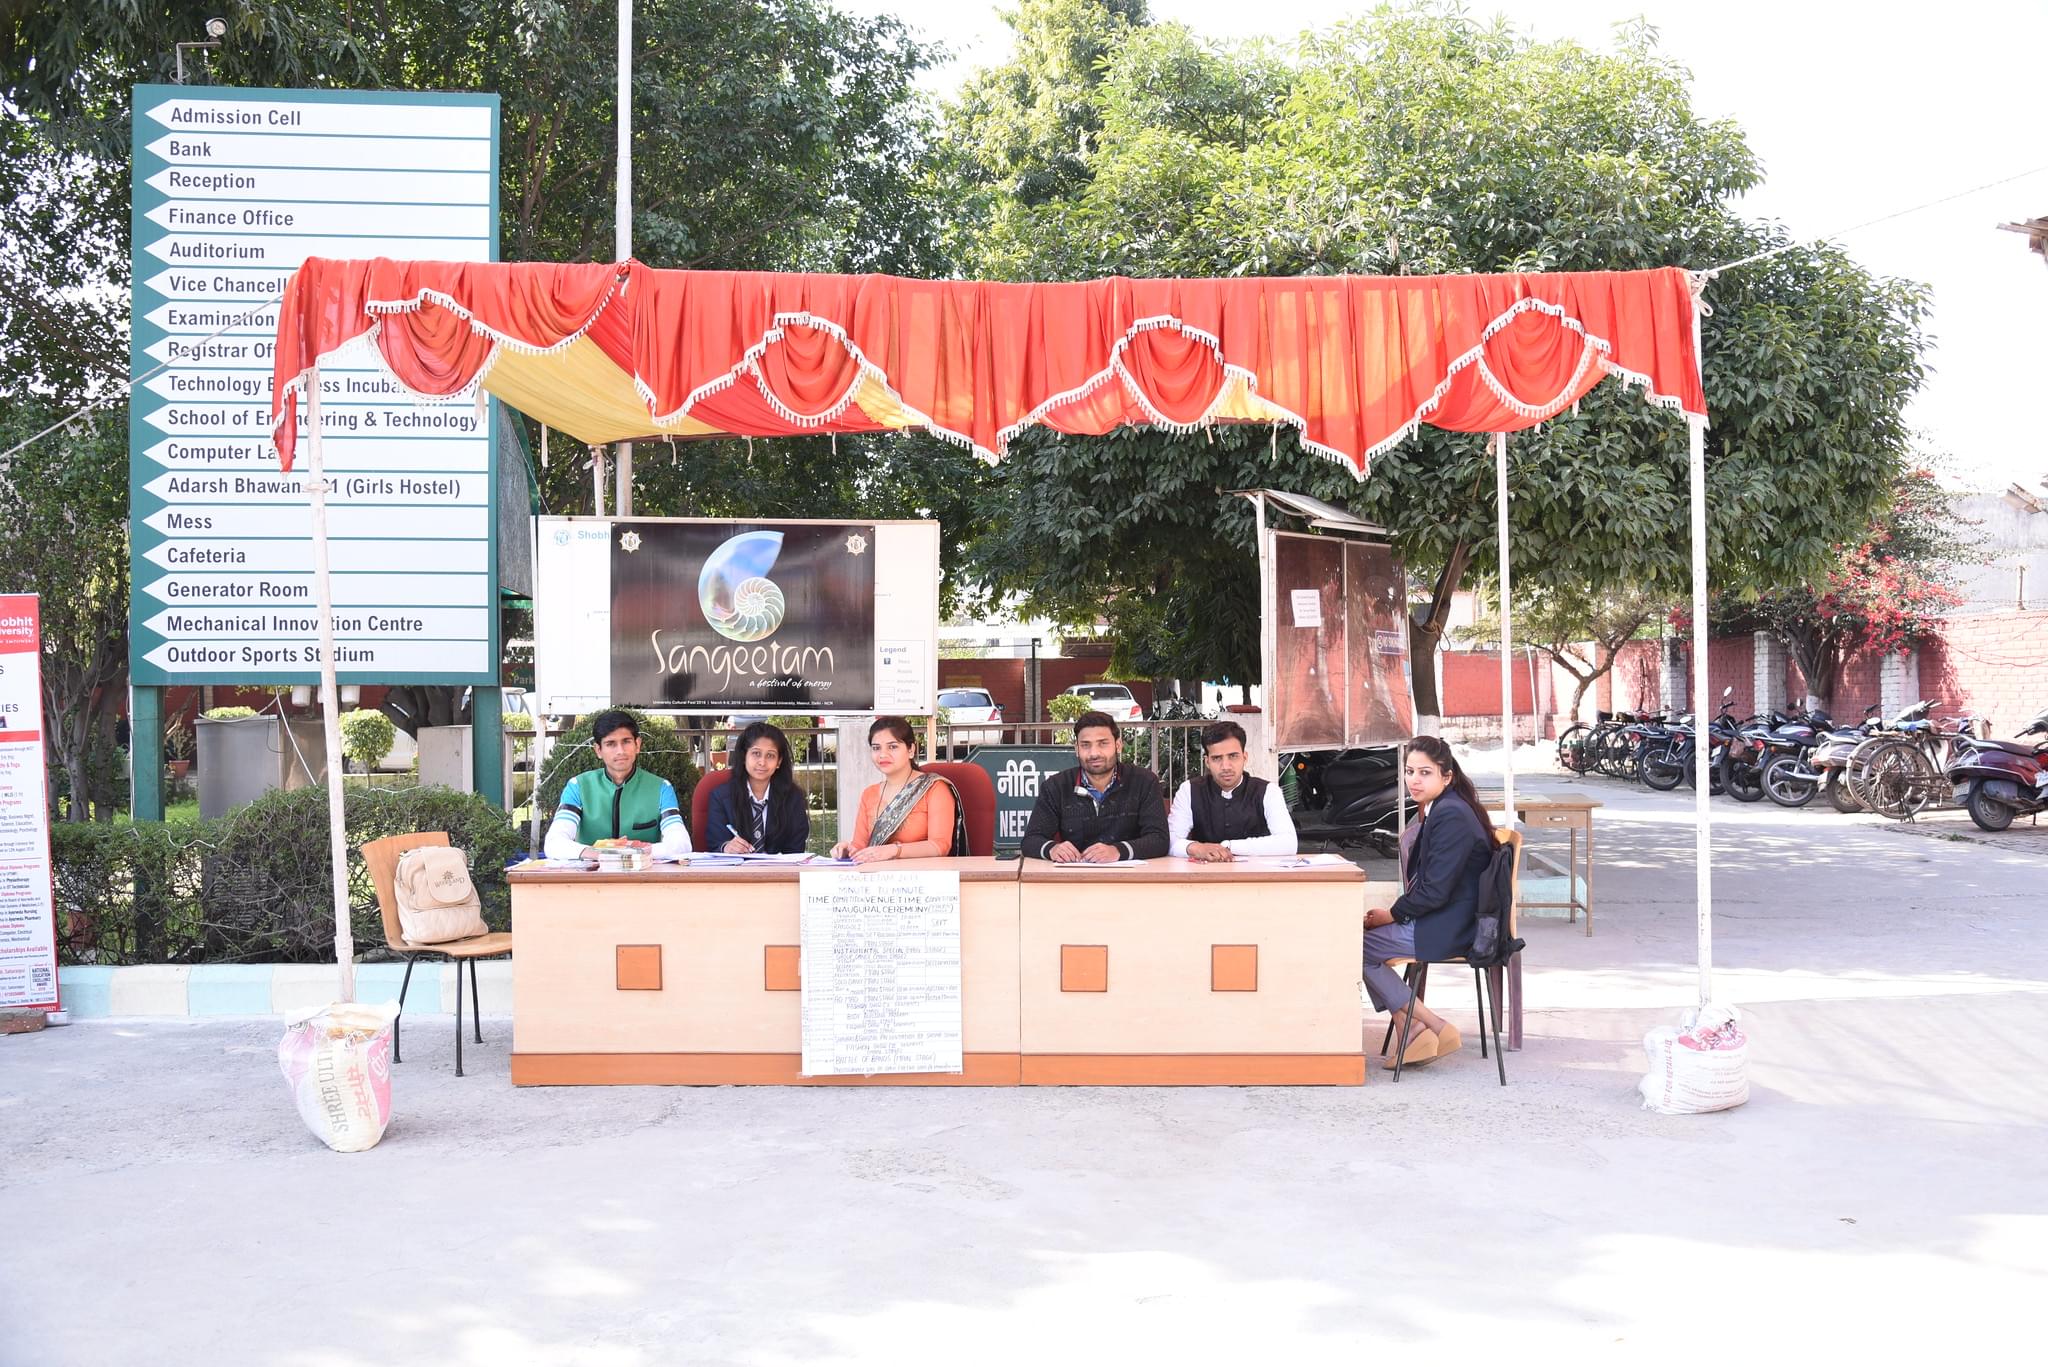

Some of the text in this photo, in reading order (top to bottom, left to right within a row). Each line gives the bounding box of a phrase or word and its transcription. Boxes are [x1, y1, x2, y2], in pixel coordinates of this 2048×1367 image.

[171, 107, 301, 126] Admission Cell
[170, 140, 211, 157] Bank
[169, 171, 255, 192] Reception
[169, 208, 294, 226] Finance Office
[169, 242, 265, 259] Auditorium
[169, 275, 207, 292] Vice
[168, 309, 275, 327] Examination
[168, 341, 249, 362] Registrar
[168, 375, 261, 396] Technology
[168, 409, 225, 426] School
[232, 410, 249, 426] of
[364, 411, 377, 427] &
[383, 411, 477, 432] Technology
[168, 443, 252, 463] Computer
[168, 477, 228, 493] Adarsh
[235, 477, 301, 494] Bhawan
[346, 478, 393, 498] (Girls
[400, 479, 460, 499] Hostel)
[167, 513, 212, 529] Mess
[167, 547, 246, 563] Cafeteria
[167, 581, 308, 598] Generator Room
[167, 615, 423, 632] Mechanical Innovtion Centre
[167, 646, 374, 666] Outdoor Sports Stdium
[880, 646, 907, 656] Legend
[651, 629, 834, 693] Sangeetam
[757, 678, 791, 689] festival
[792, 678, 803, 688] of
[804, 680, 832, 690] energy
[997, 759, 1040, 798] नीति
[321, 1085, 349, 1133] SHREE
